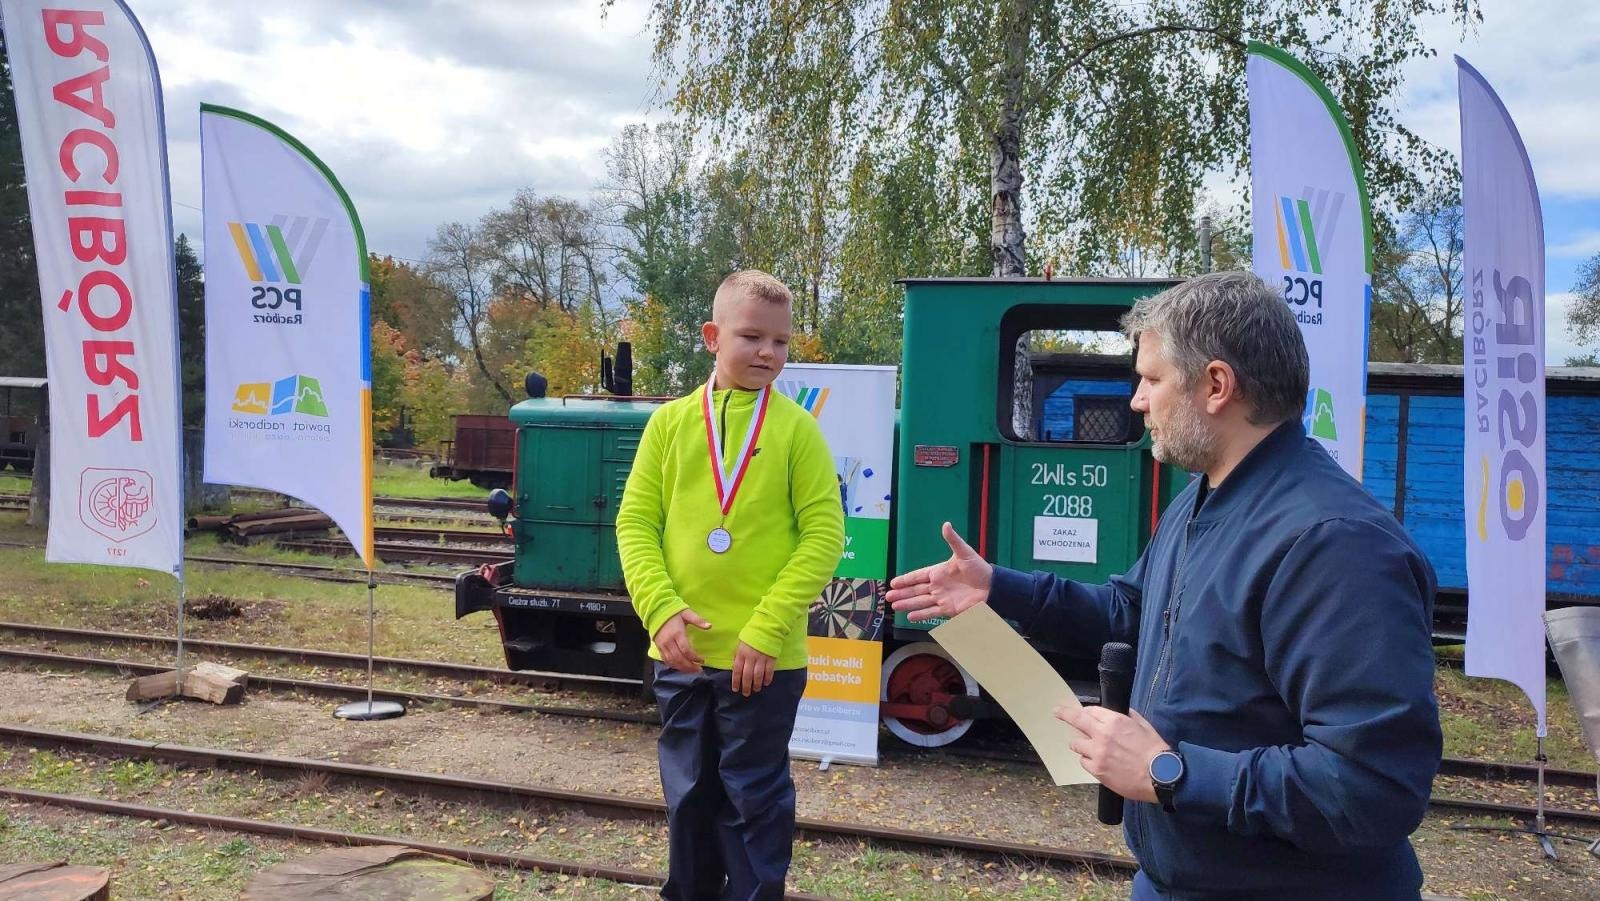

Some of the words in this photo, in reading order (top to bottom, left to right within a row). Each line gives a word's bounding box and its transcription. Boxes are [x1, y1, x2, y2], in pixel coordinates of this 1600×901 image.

[1082, 464, 1107, 487] 50
[1042, 494, 1092, 517] 2088
[1053, 528, 1077, 536] ZAKAZ
[1039, 539, 1091, 549] WCHODZENIA
[807, 655, 830, 666] tuki
[832, 657, 863, 669] walki
[807, 671, 862, 685] robatyka
